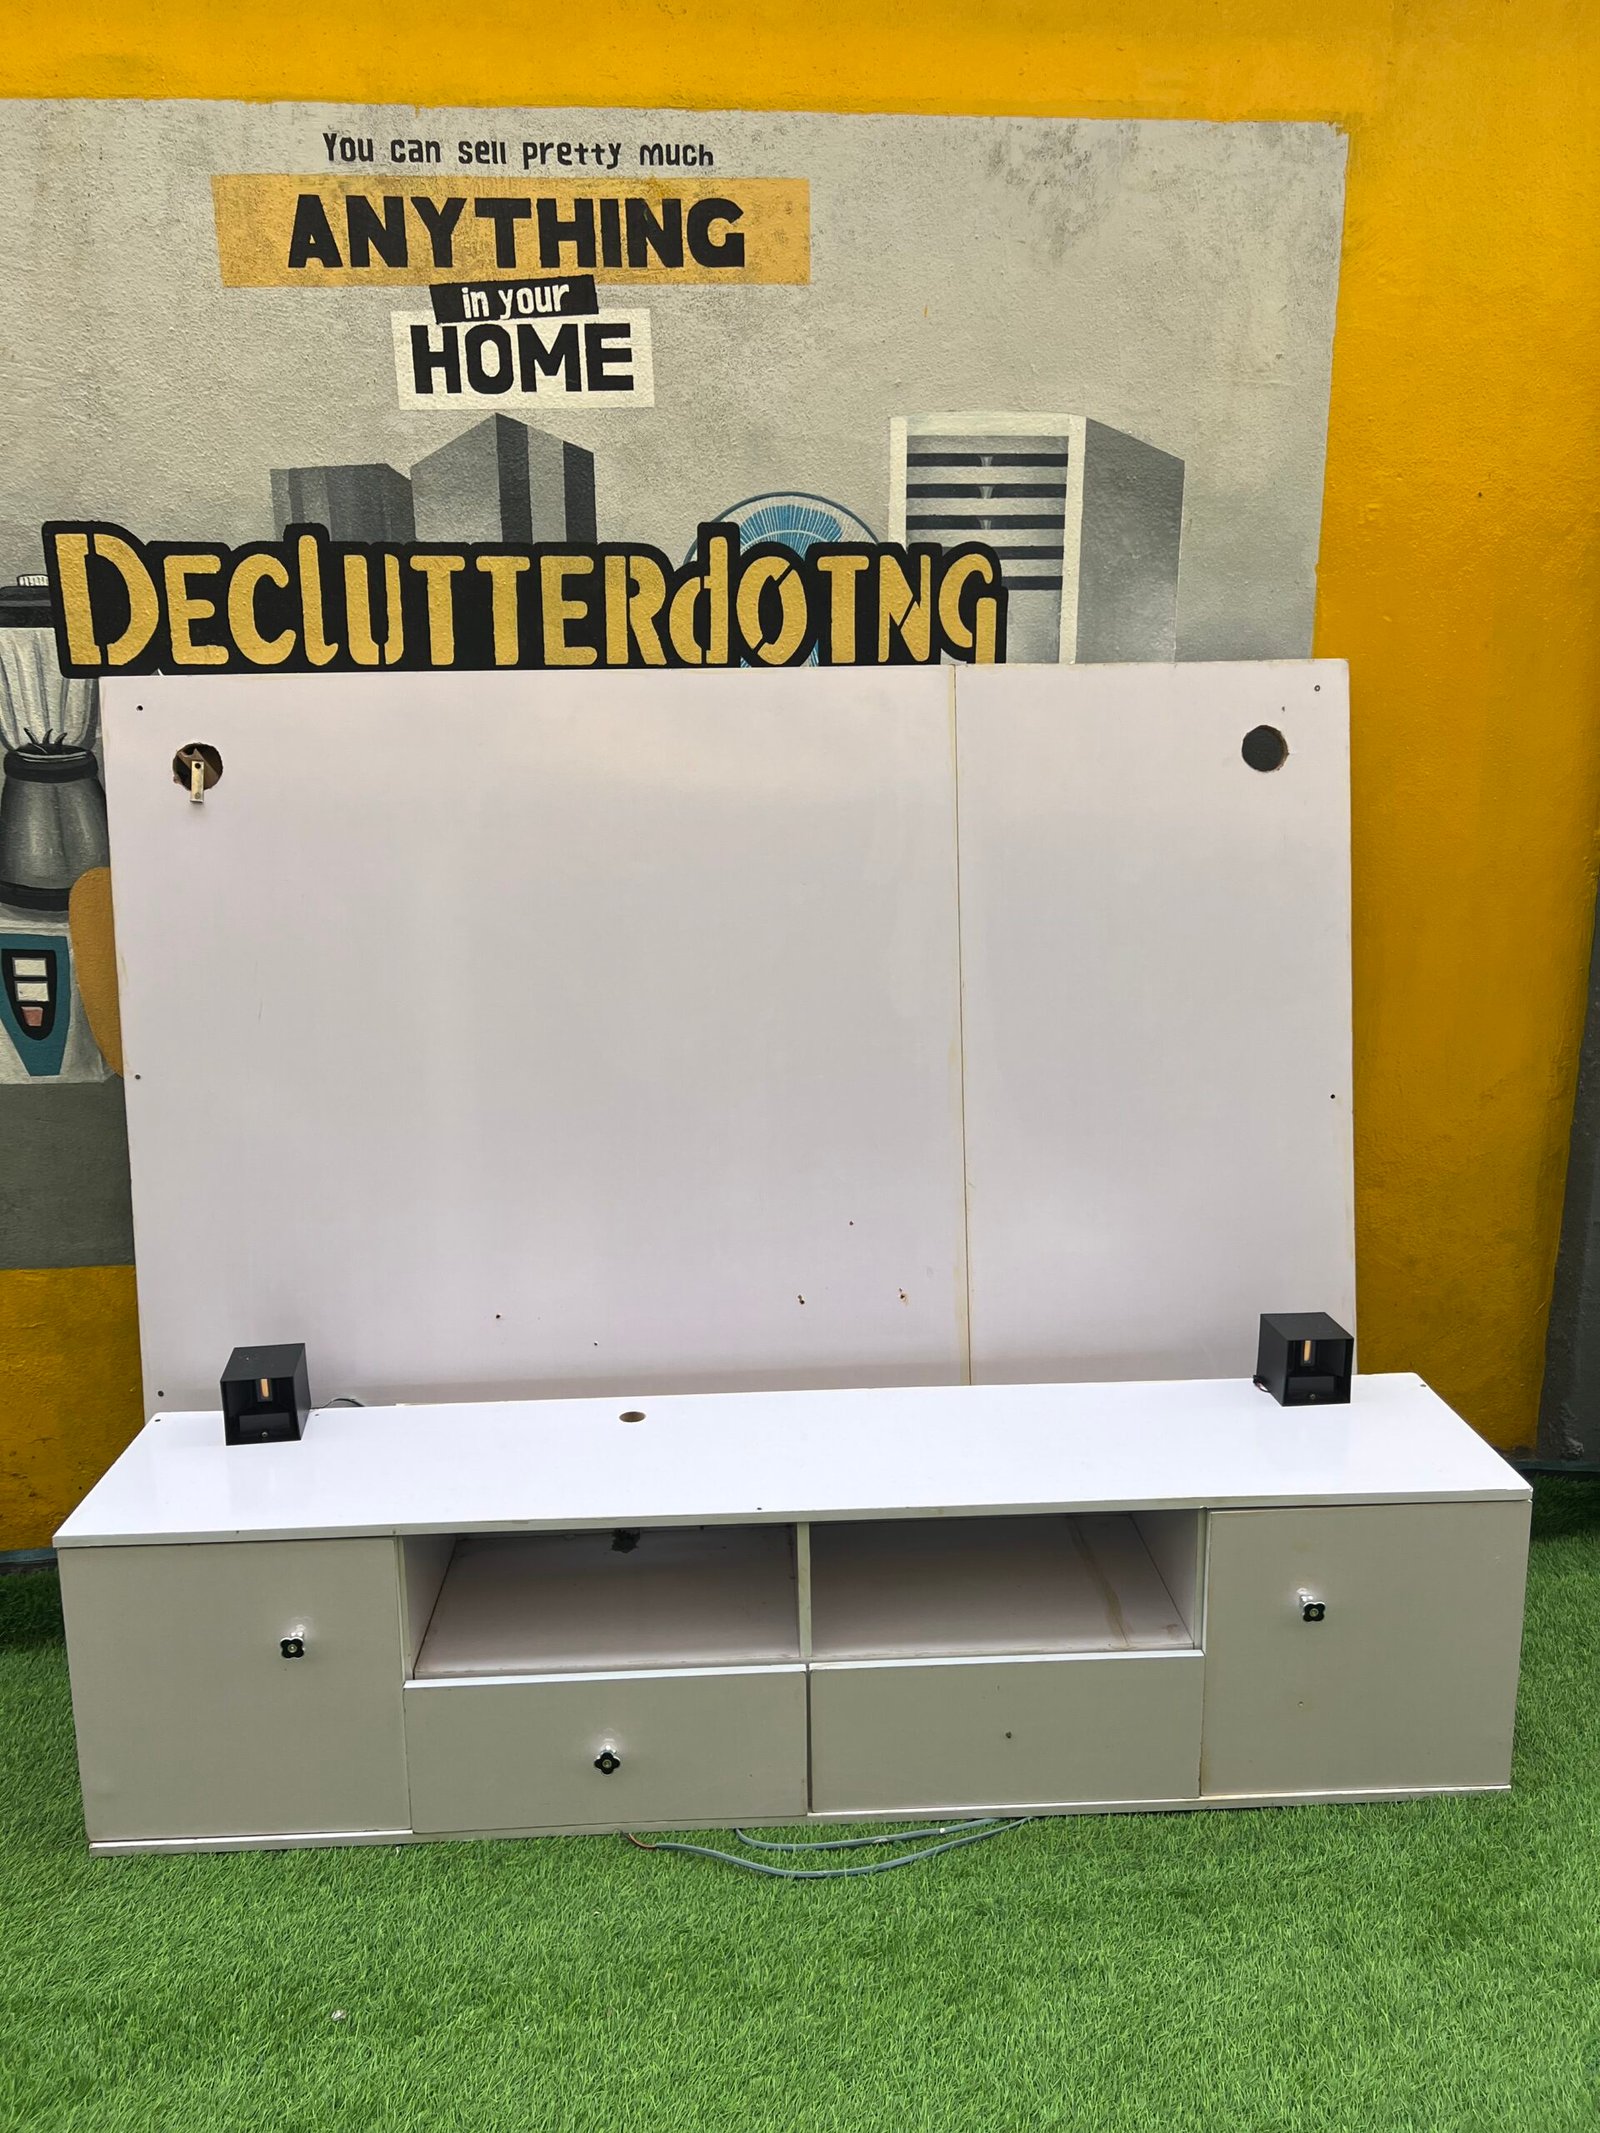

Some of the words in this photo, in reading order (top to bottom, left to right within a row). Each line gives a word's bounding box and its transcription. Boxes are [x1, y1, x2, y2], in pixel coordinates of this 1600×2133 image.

[323, 133, 374, 162] You
[390, 139, 441, 163] can
[458, 140, 507, 164] sell
[523, 142, 622, 170] pretty
[639, 143, 714, 166] much
[288, 194, 745, 268] ANYTHING
[461, 287, 490, 319] in
[498, 284, 570, 320] your
[410, 323, 634, 394] HOME
